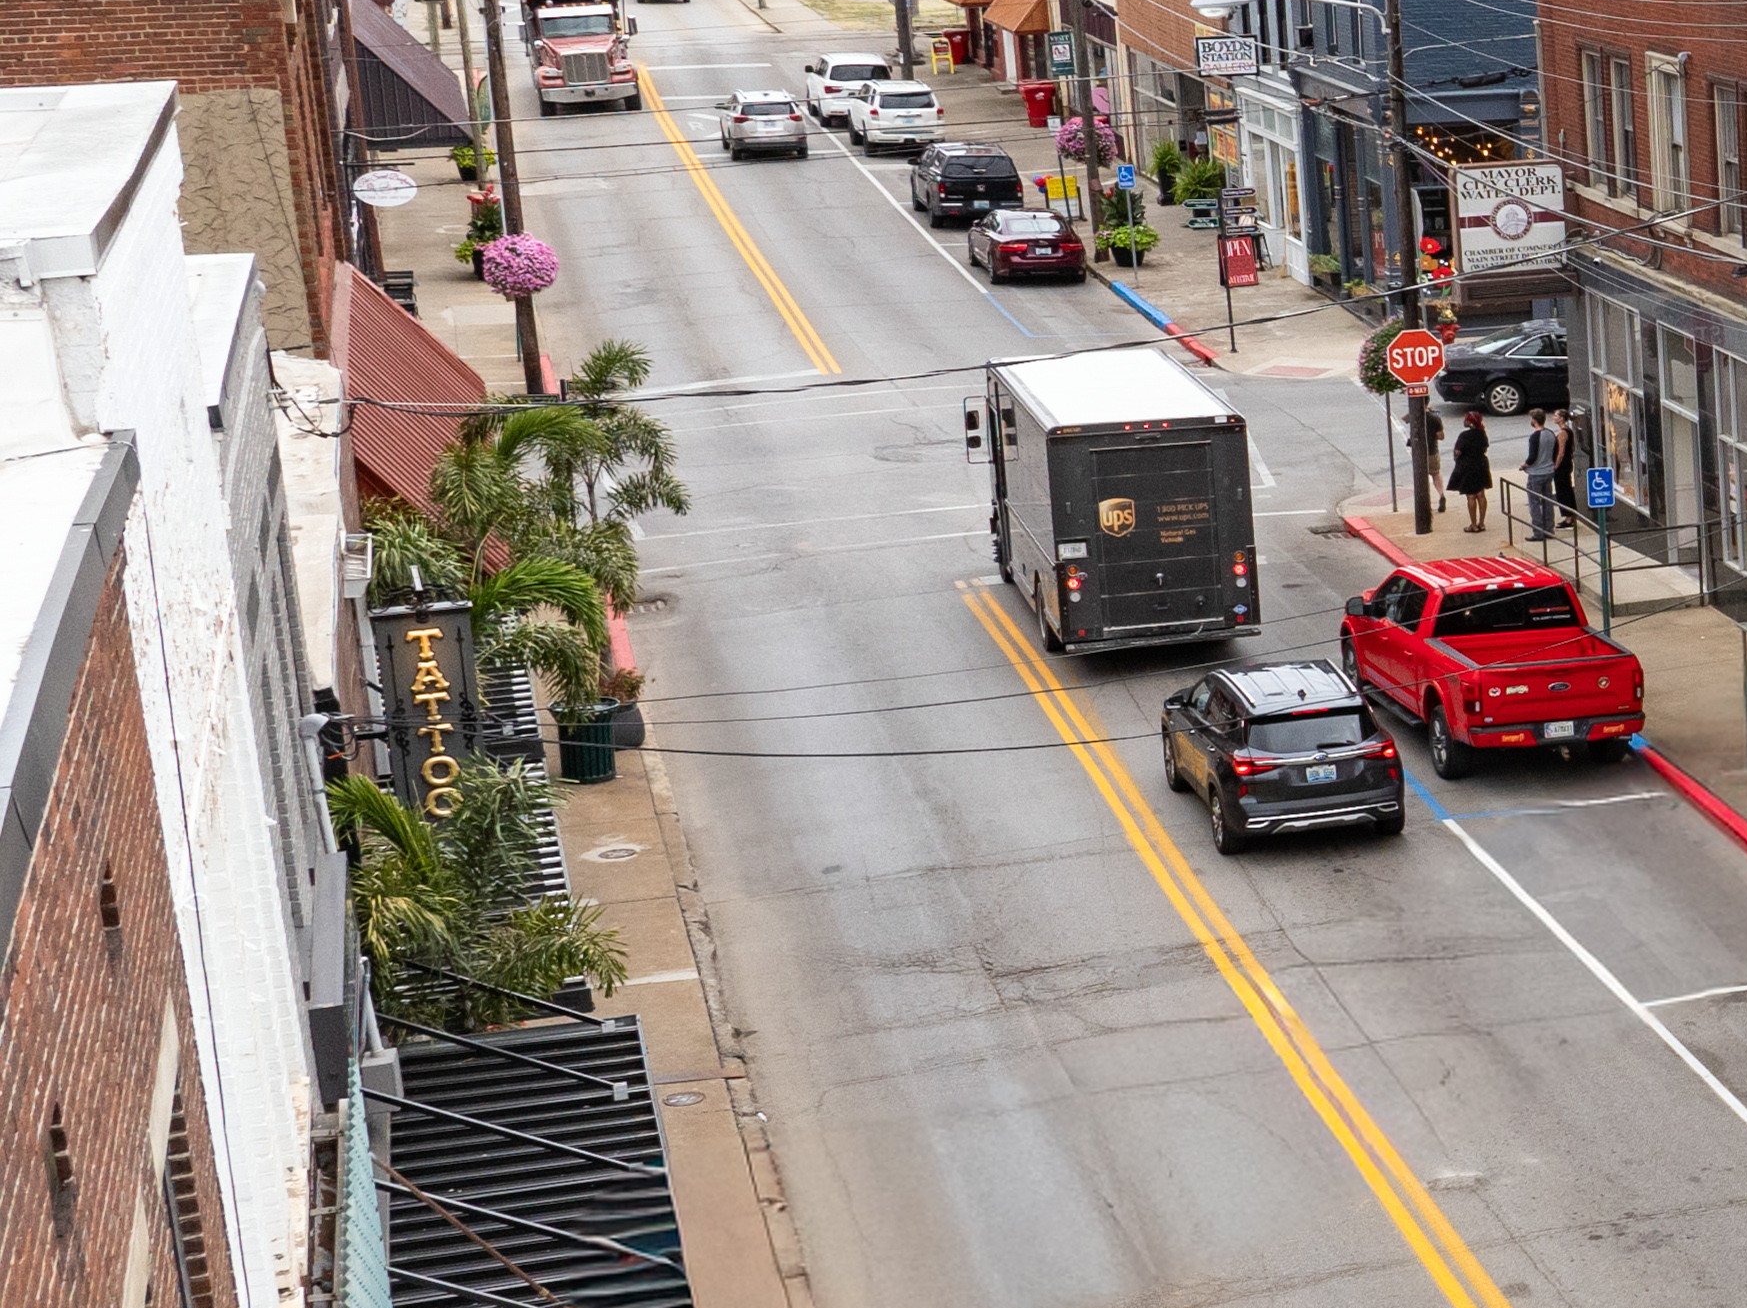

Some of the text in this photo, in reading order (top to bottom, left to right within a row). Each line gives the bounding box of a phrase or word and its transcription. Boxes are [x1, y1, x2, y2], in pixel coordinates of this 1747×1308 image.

[1201, 40, 1253, 53] BOYDS
[1202, 51, 1252, 62] STATION
[1481, 167, 1538, 180] MAYOR
[1504, 175, 1558, 188] CLERK
[1520, 184, 1561, 197] DEPT.
[1392, 345, 1440, 369] STOP
[1102, 509, 1134, 532] ups
